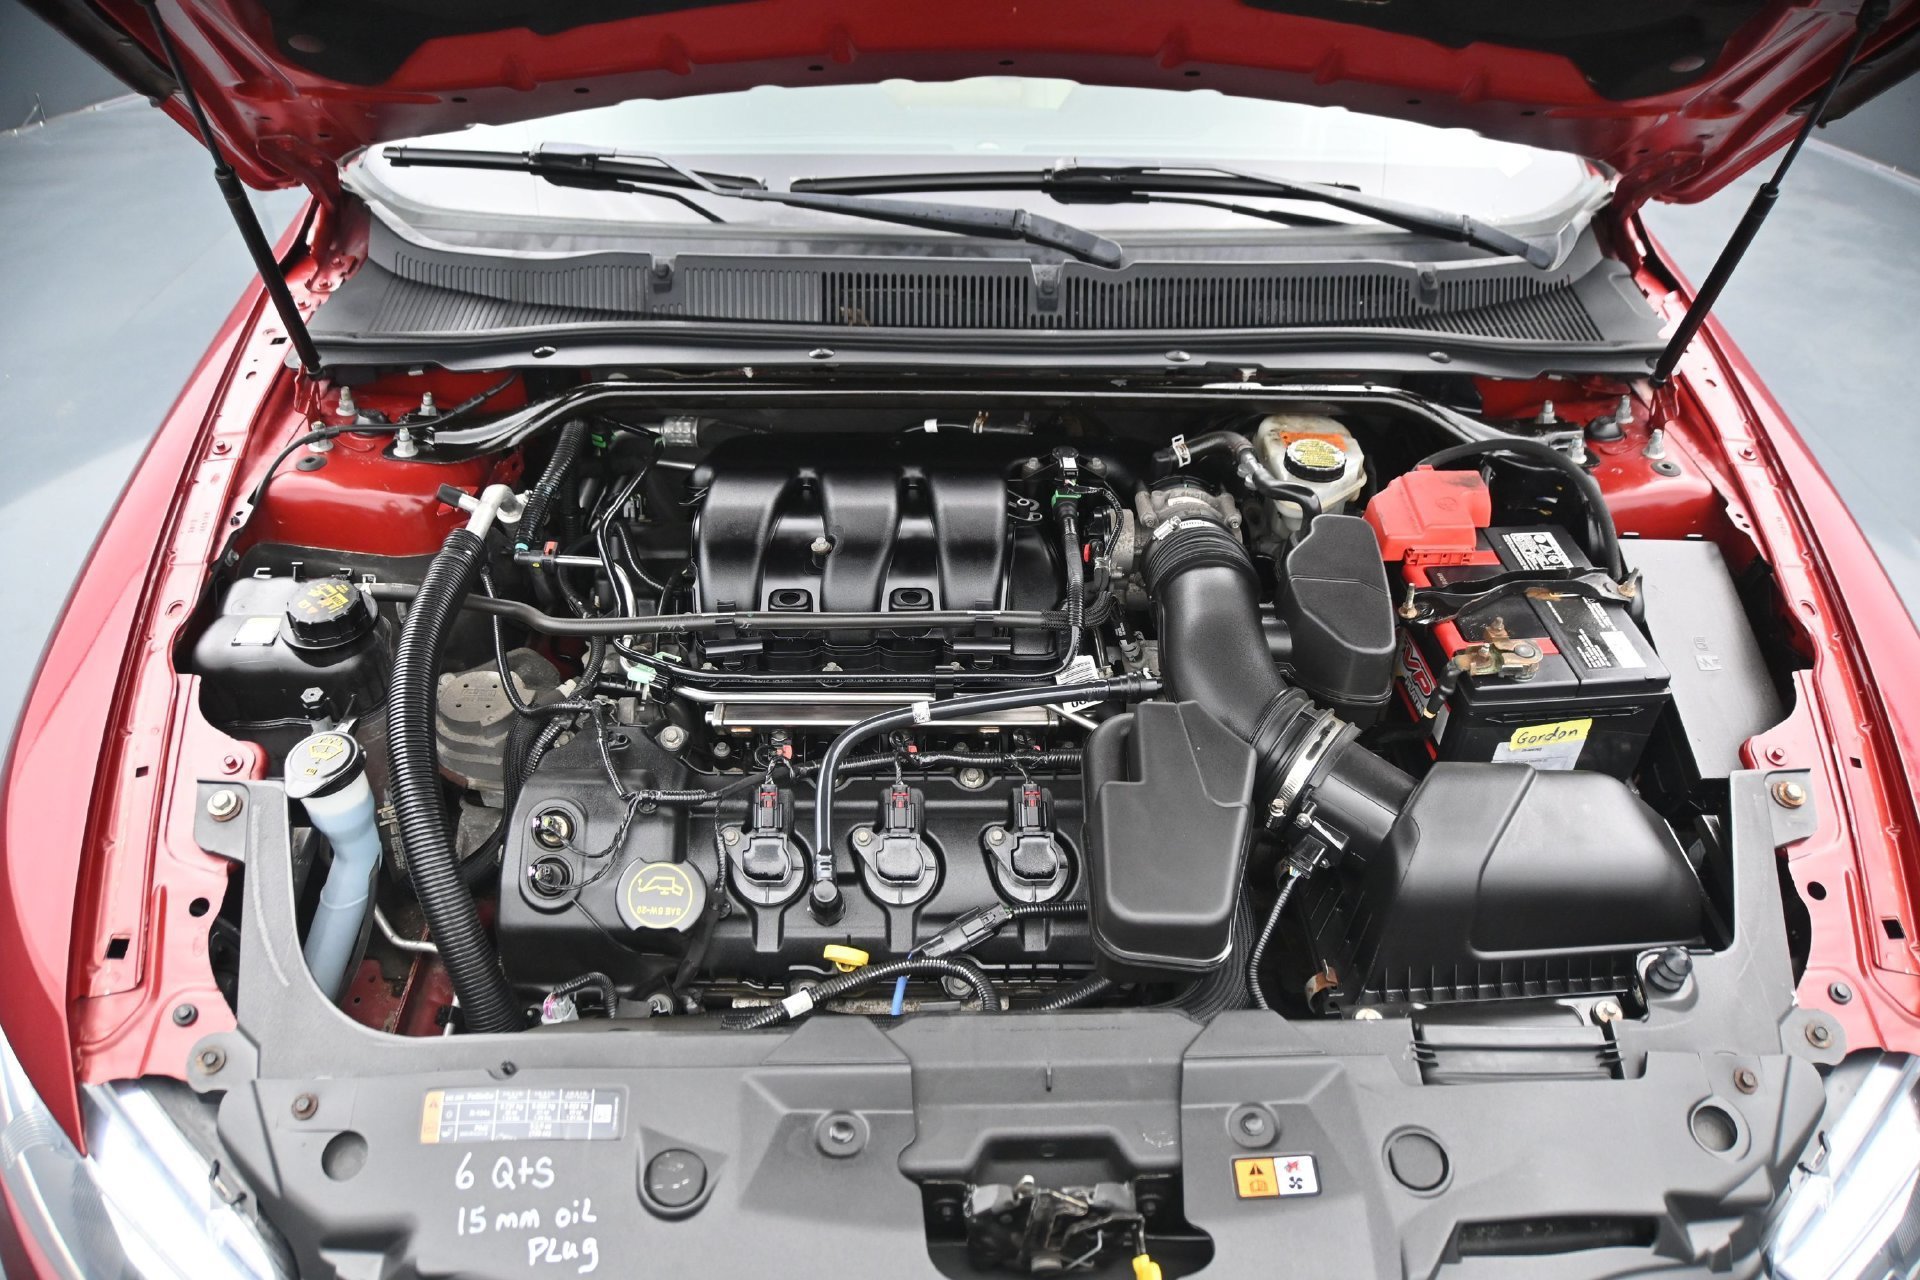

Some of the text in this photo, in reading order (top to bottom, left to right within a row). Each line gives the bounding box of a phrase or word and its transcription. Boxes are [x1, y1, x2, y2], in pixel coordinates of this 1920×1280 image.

[1403, 636, 1432, 697] VP
[1516, 726, 1578, 744] Gordon
[455, 1151, 475, 1190] 6
[457, 1205, 487, 1236] 15
[495, 1208, 541, 1231] mm
